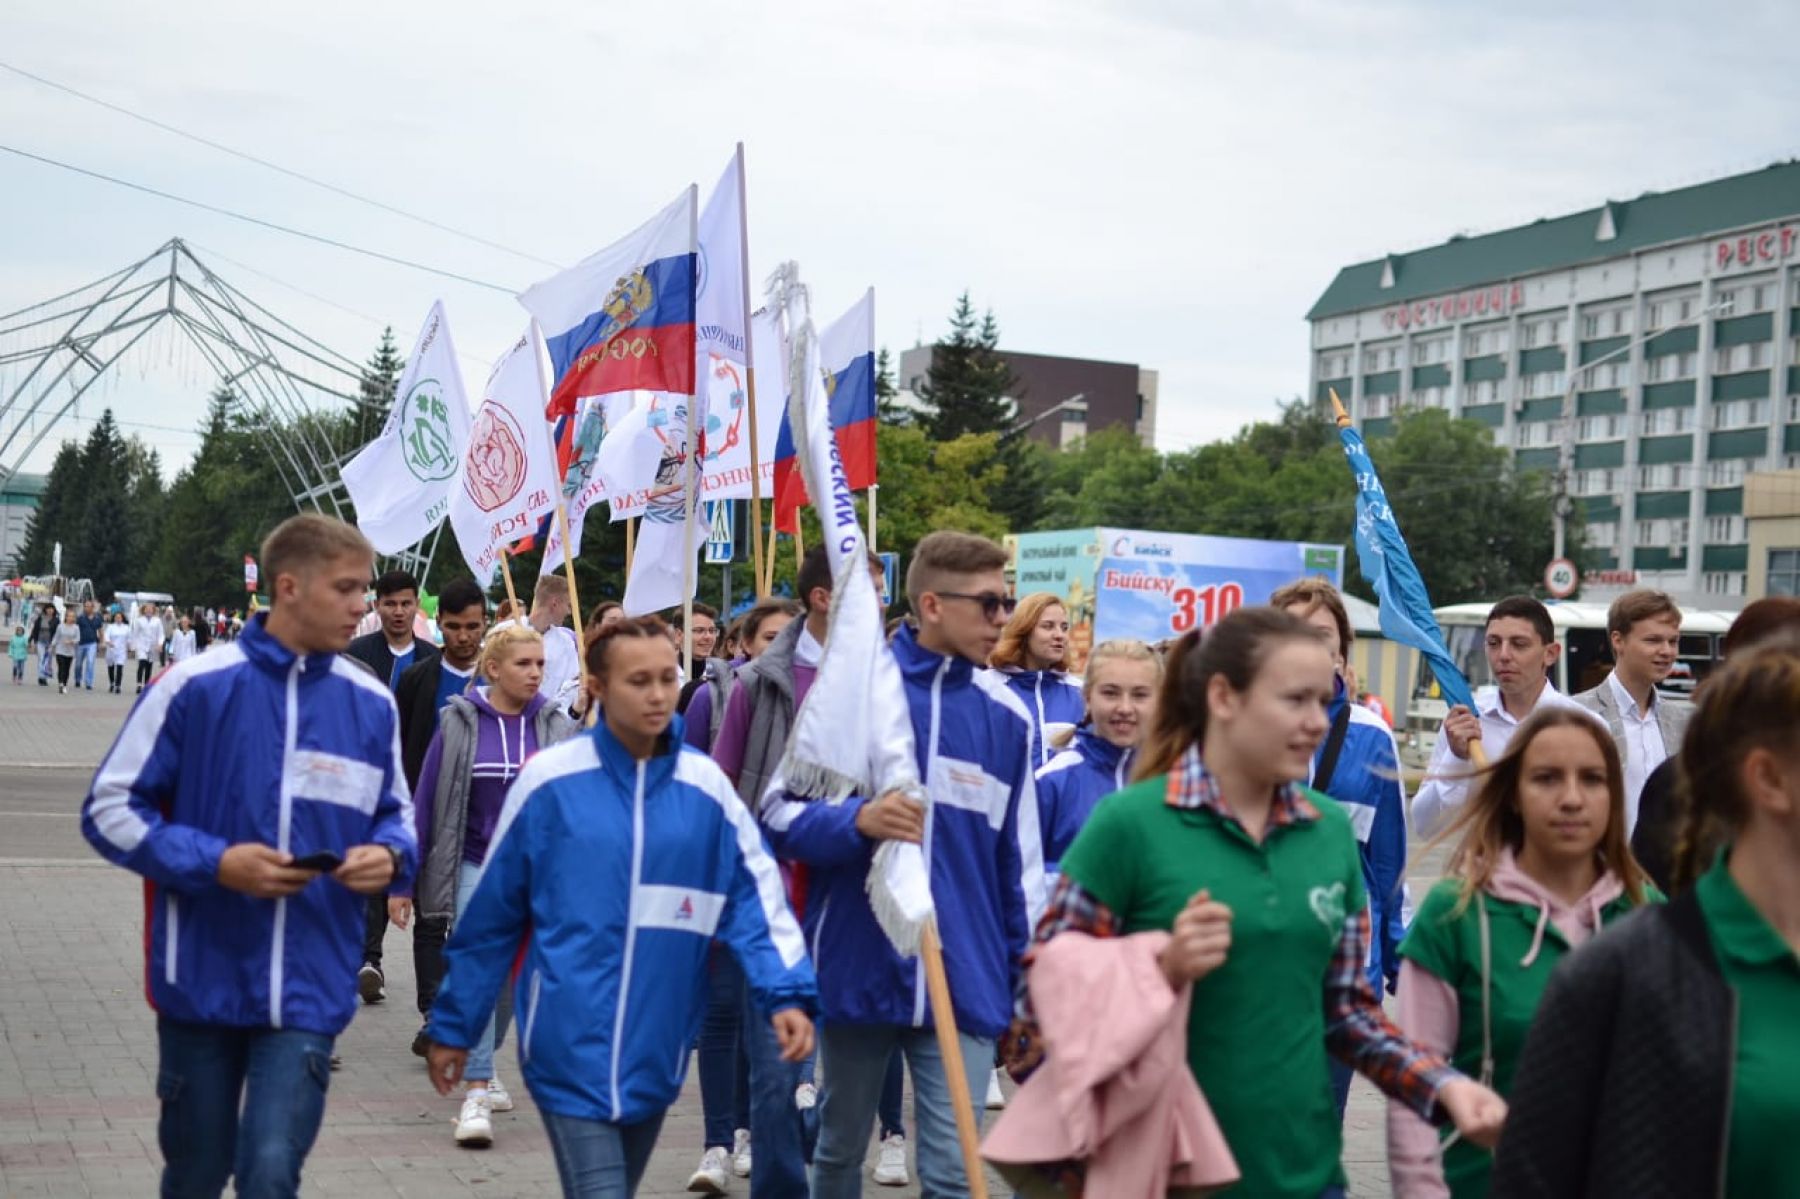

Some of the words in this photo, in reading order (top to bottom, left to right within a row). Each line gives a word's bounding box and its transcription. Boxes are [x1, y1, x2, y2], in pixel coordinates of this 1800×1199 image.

[1384, 281, 1524, 331] ГОСТИНИЦА
[1105, 569, 1175, 596] Бийску
[1171, 583, 1242, 632] 310
[1553, 570, 1570, 584] 40
